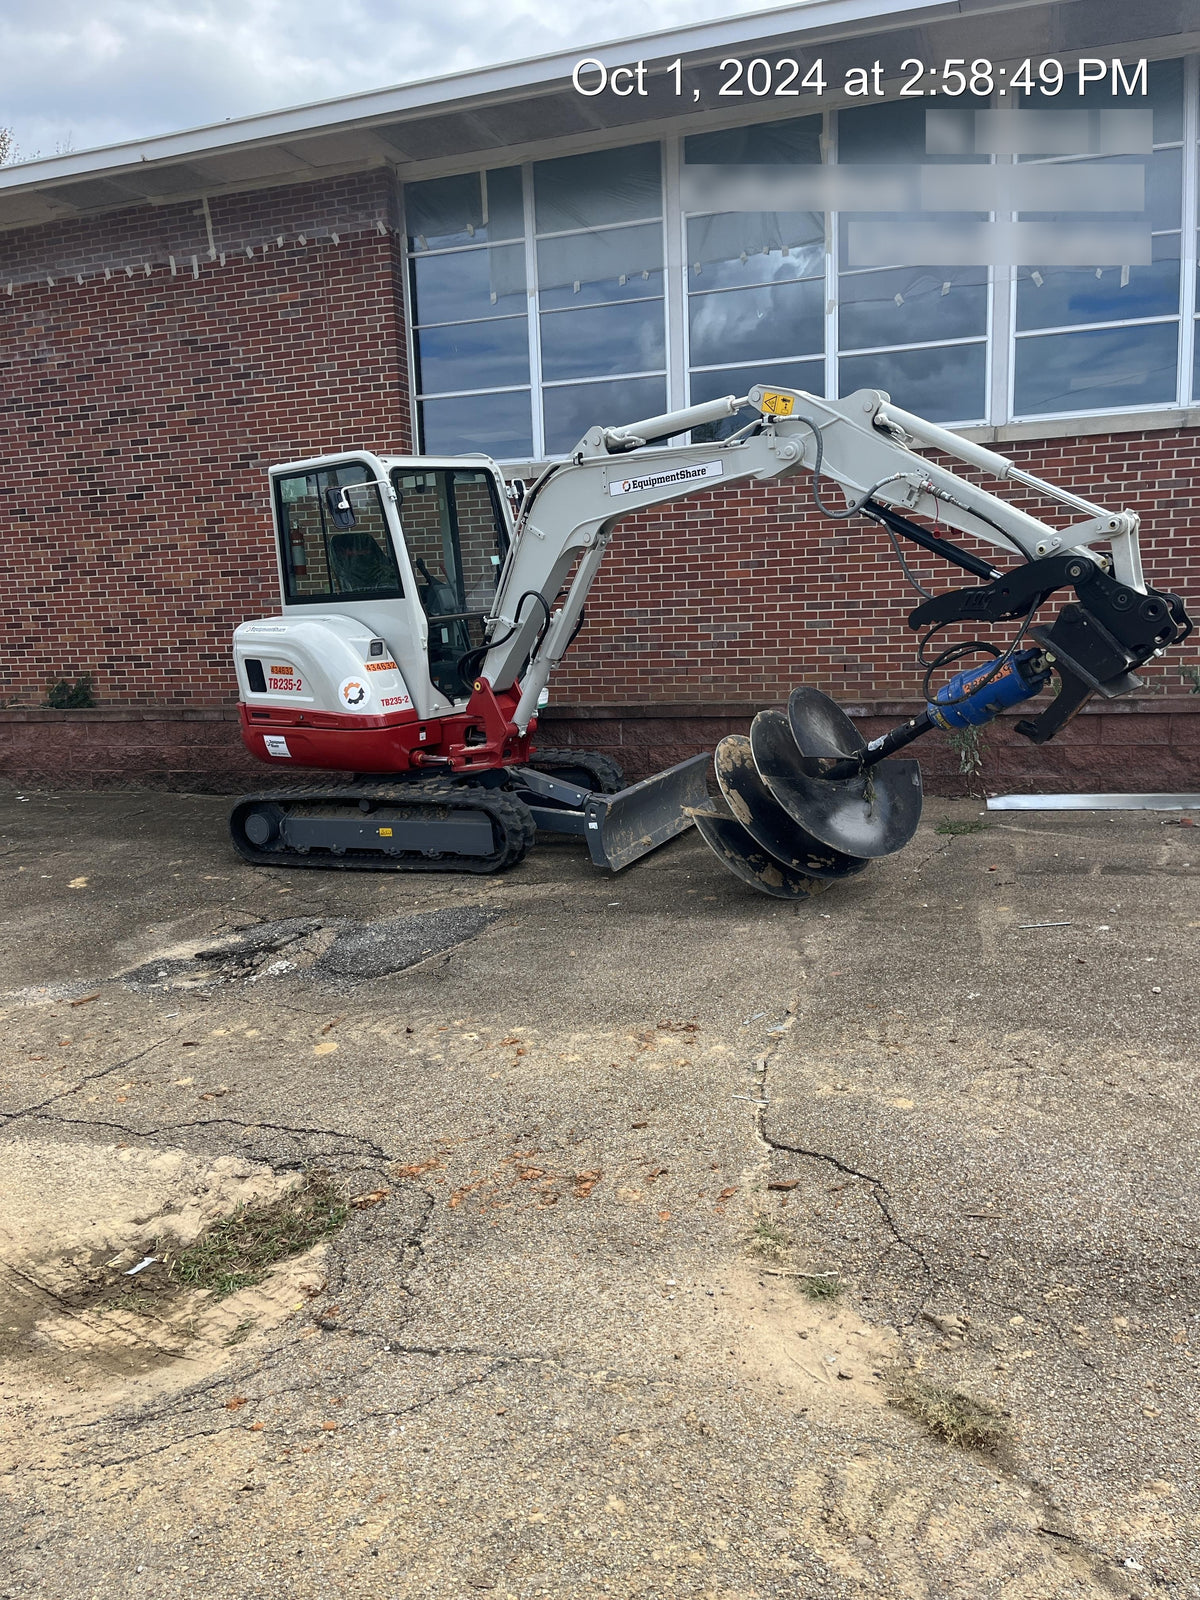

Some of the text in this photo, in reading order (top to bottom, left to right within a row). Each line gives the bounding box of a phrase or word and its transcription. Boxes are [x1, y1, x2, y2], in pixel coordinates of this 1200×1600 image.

[632, 467, 706, 489] EquipmentShare
[366, 661, 397, 671] 434632
[268, 677, 303, 691] TB235-2
[380, 695, 409, 707] TB235-2
